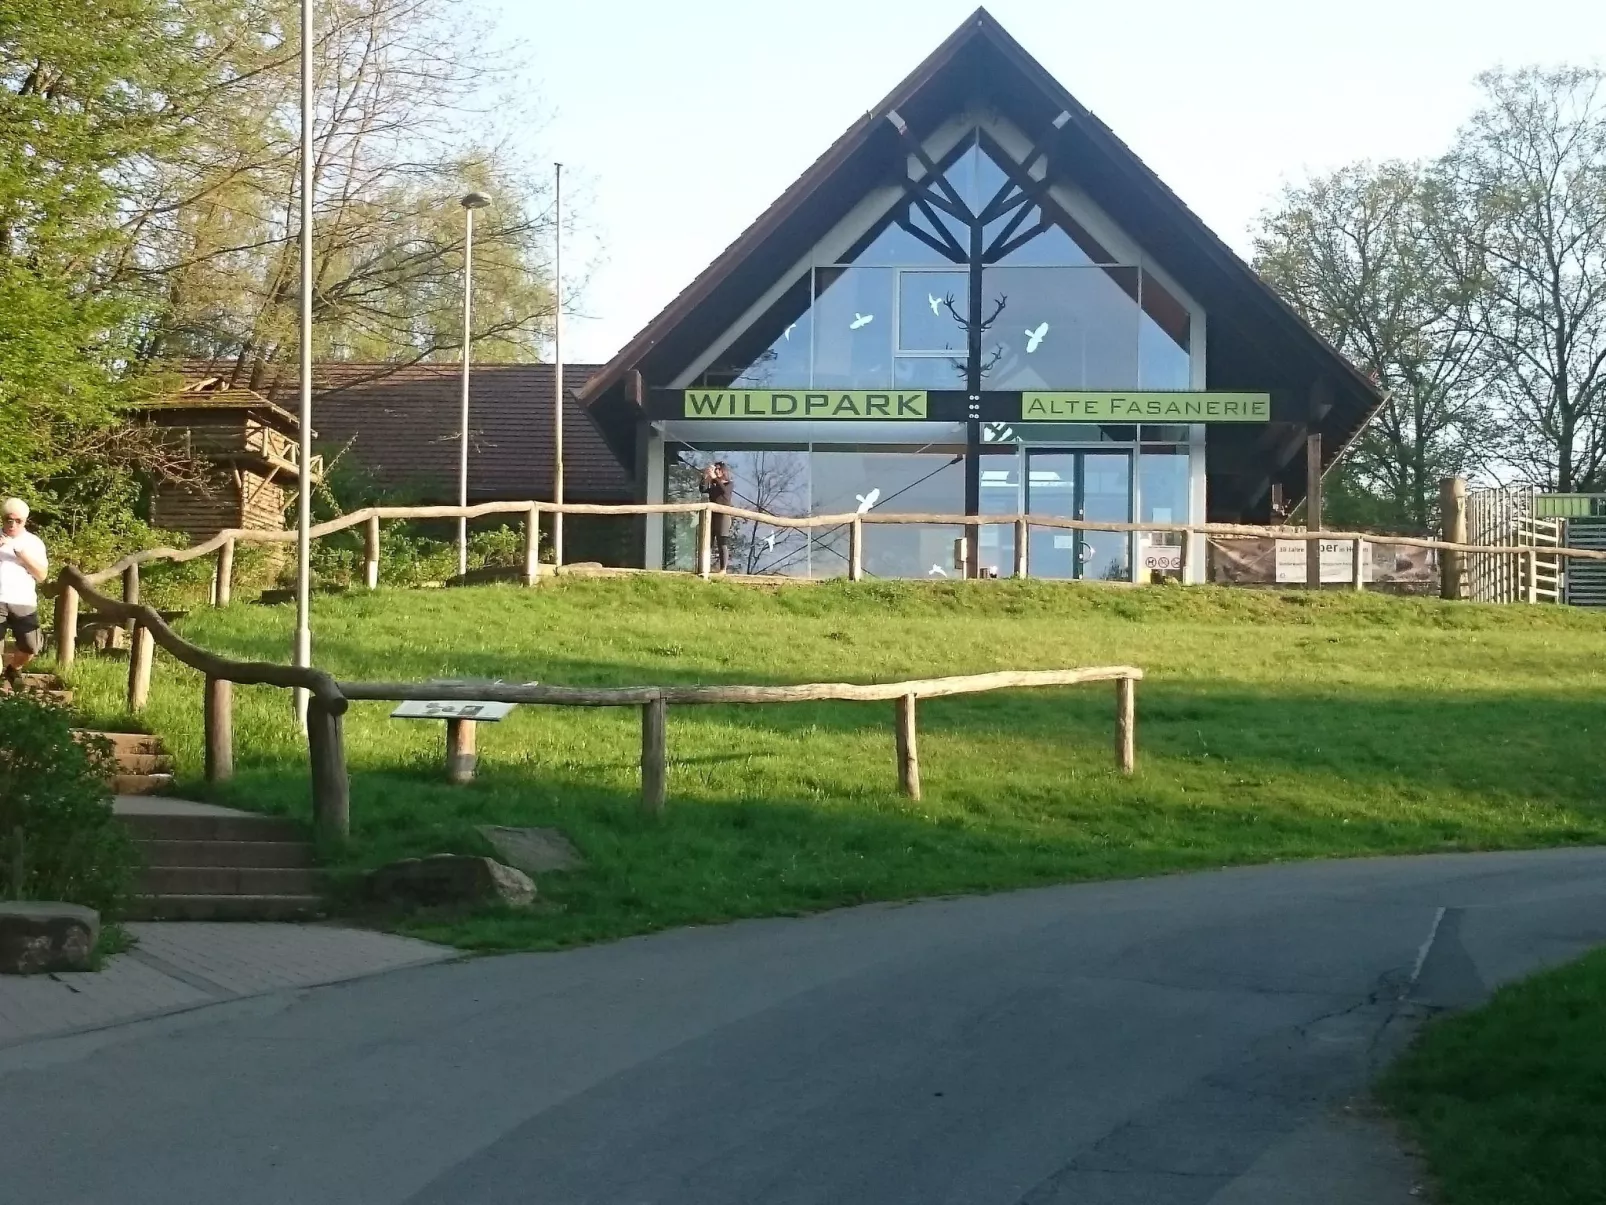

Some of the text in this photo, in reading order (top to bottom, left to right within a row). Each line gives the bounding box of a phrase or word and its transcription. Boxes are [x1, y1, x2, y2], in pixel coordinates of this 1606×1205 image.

[689, 393, 923, 416] WILDPARK
[1027, 398, 1266, 415] ALTE FASANERIE
